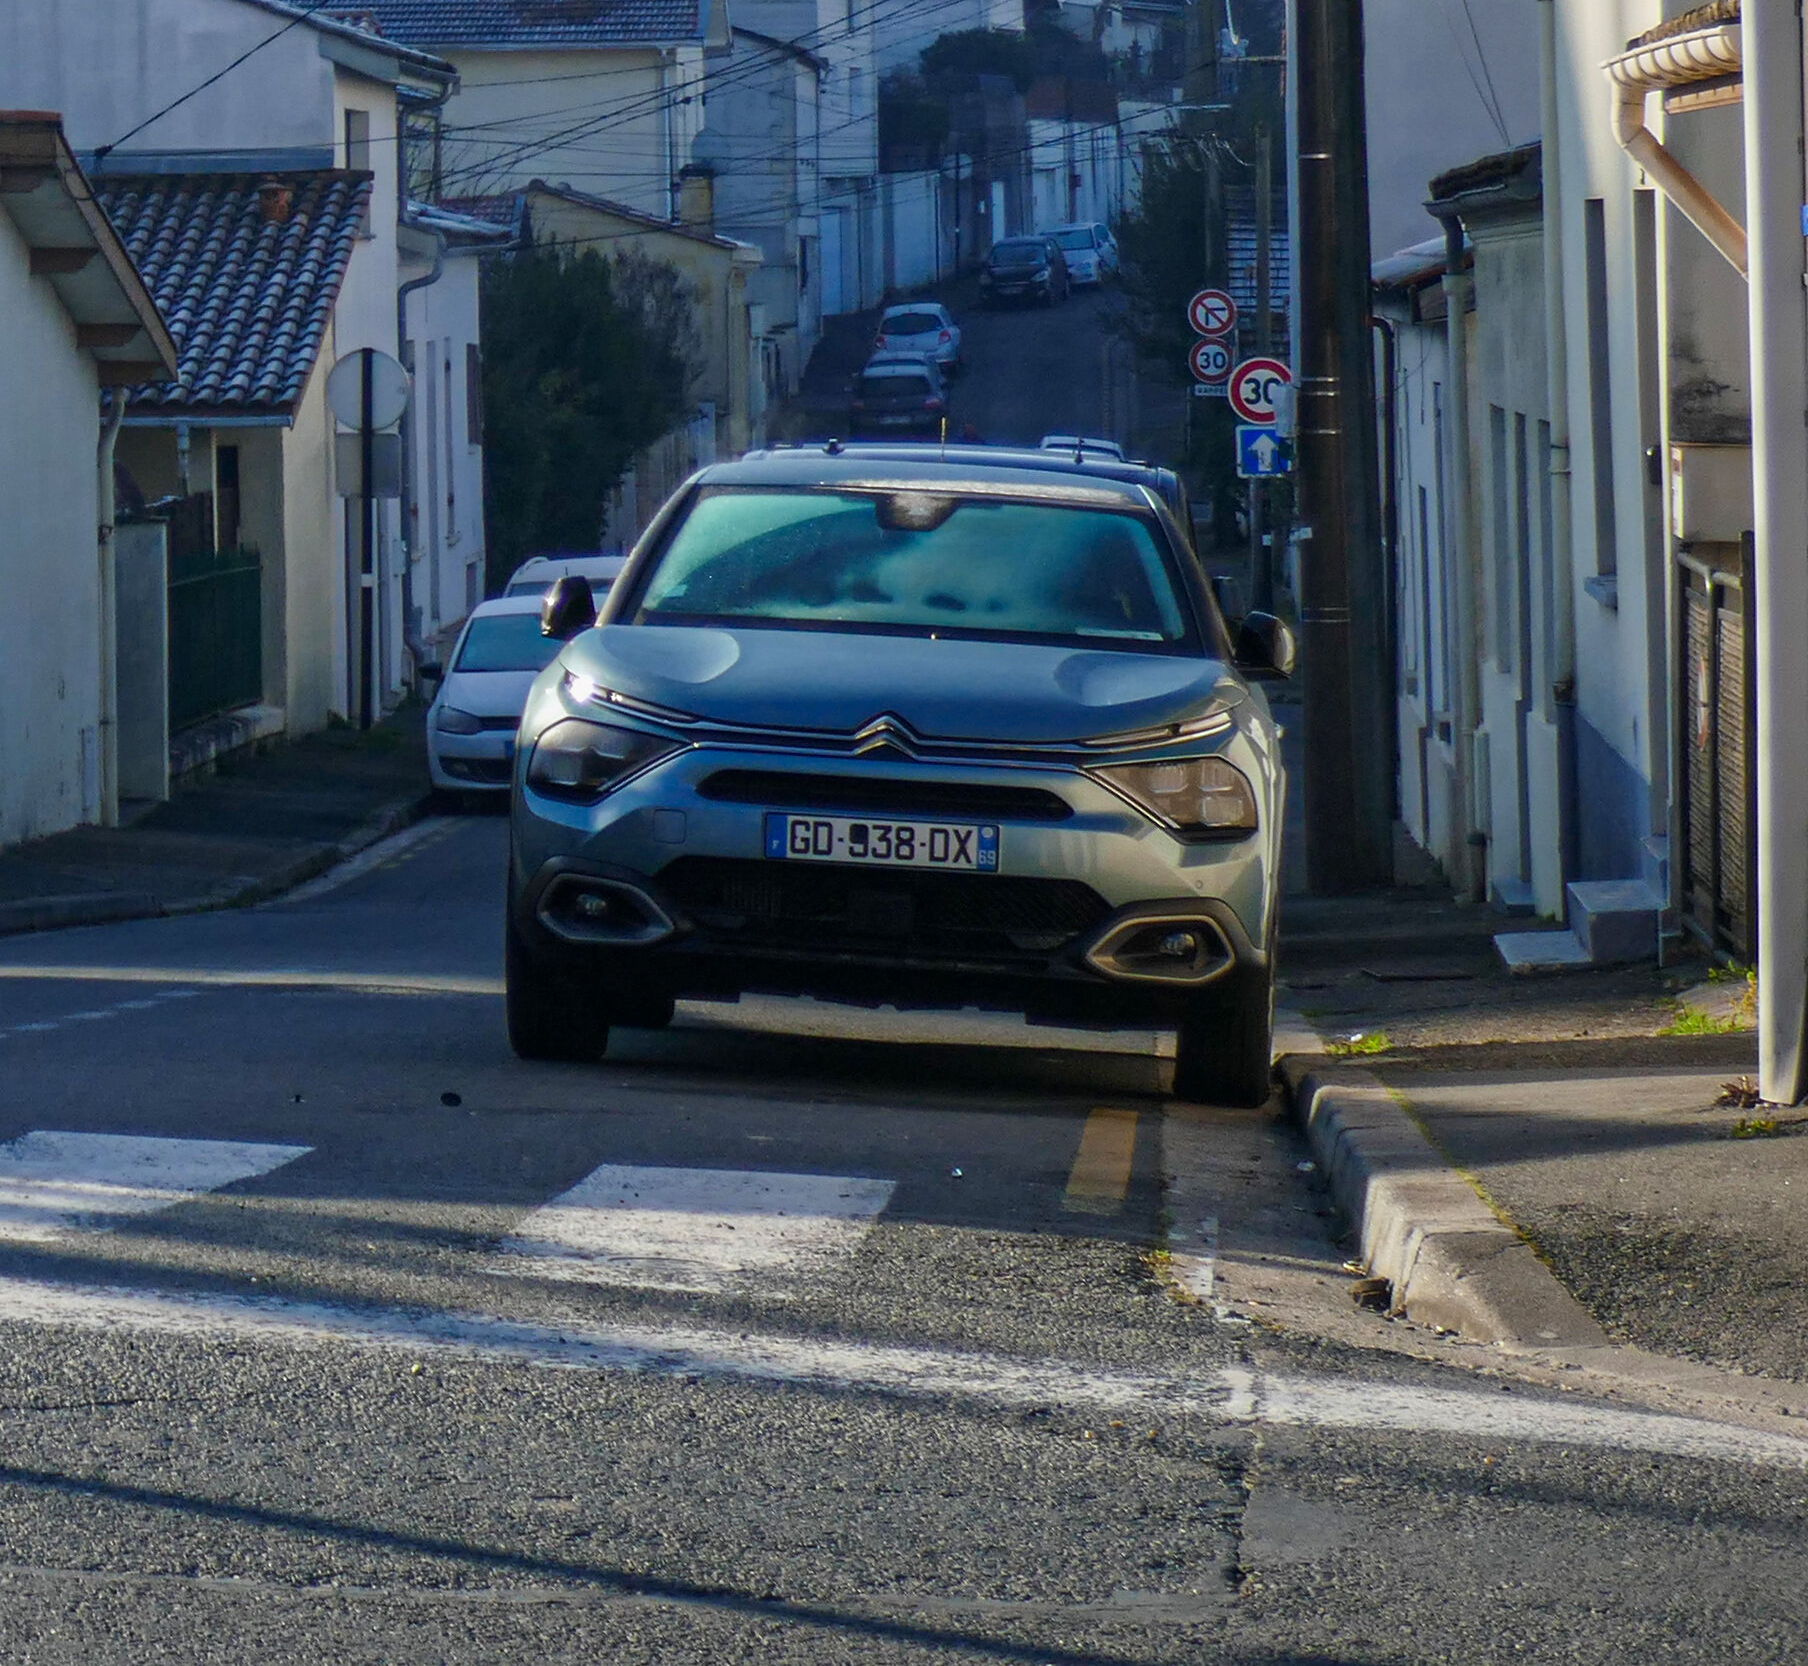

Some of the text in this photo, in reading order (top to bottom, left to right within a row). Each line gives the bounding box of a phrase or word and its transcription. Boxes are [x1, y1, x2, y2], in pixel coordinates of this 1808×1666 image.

[1199, 351, 1226, 369] 30
[789, 819, 973, 864] GD-938-DX
[978, 849, 996, 866] 69
